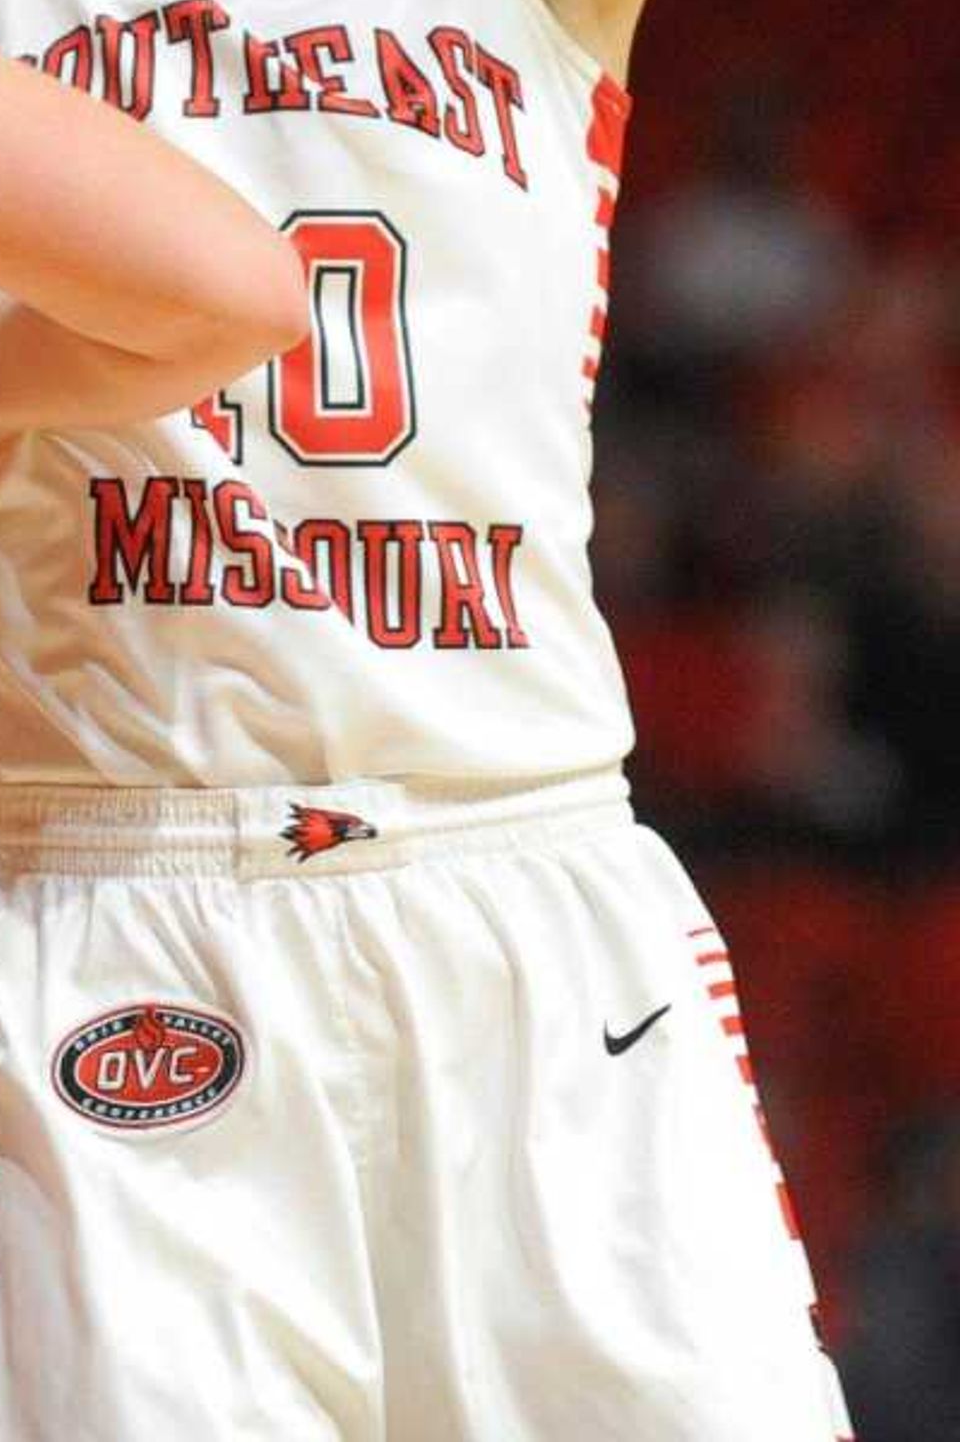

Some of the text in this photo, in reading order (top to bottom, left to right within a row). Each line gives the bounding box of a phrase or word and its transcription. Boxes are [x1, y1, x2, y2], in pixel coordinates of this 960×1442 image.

[190, 210, 417, 468] 0
[89, 476, 531, 650] MISSOURI
[96, 1045, 198, 1091] OVC
